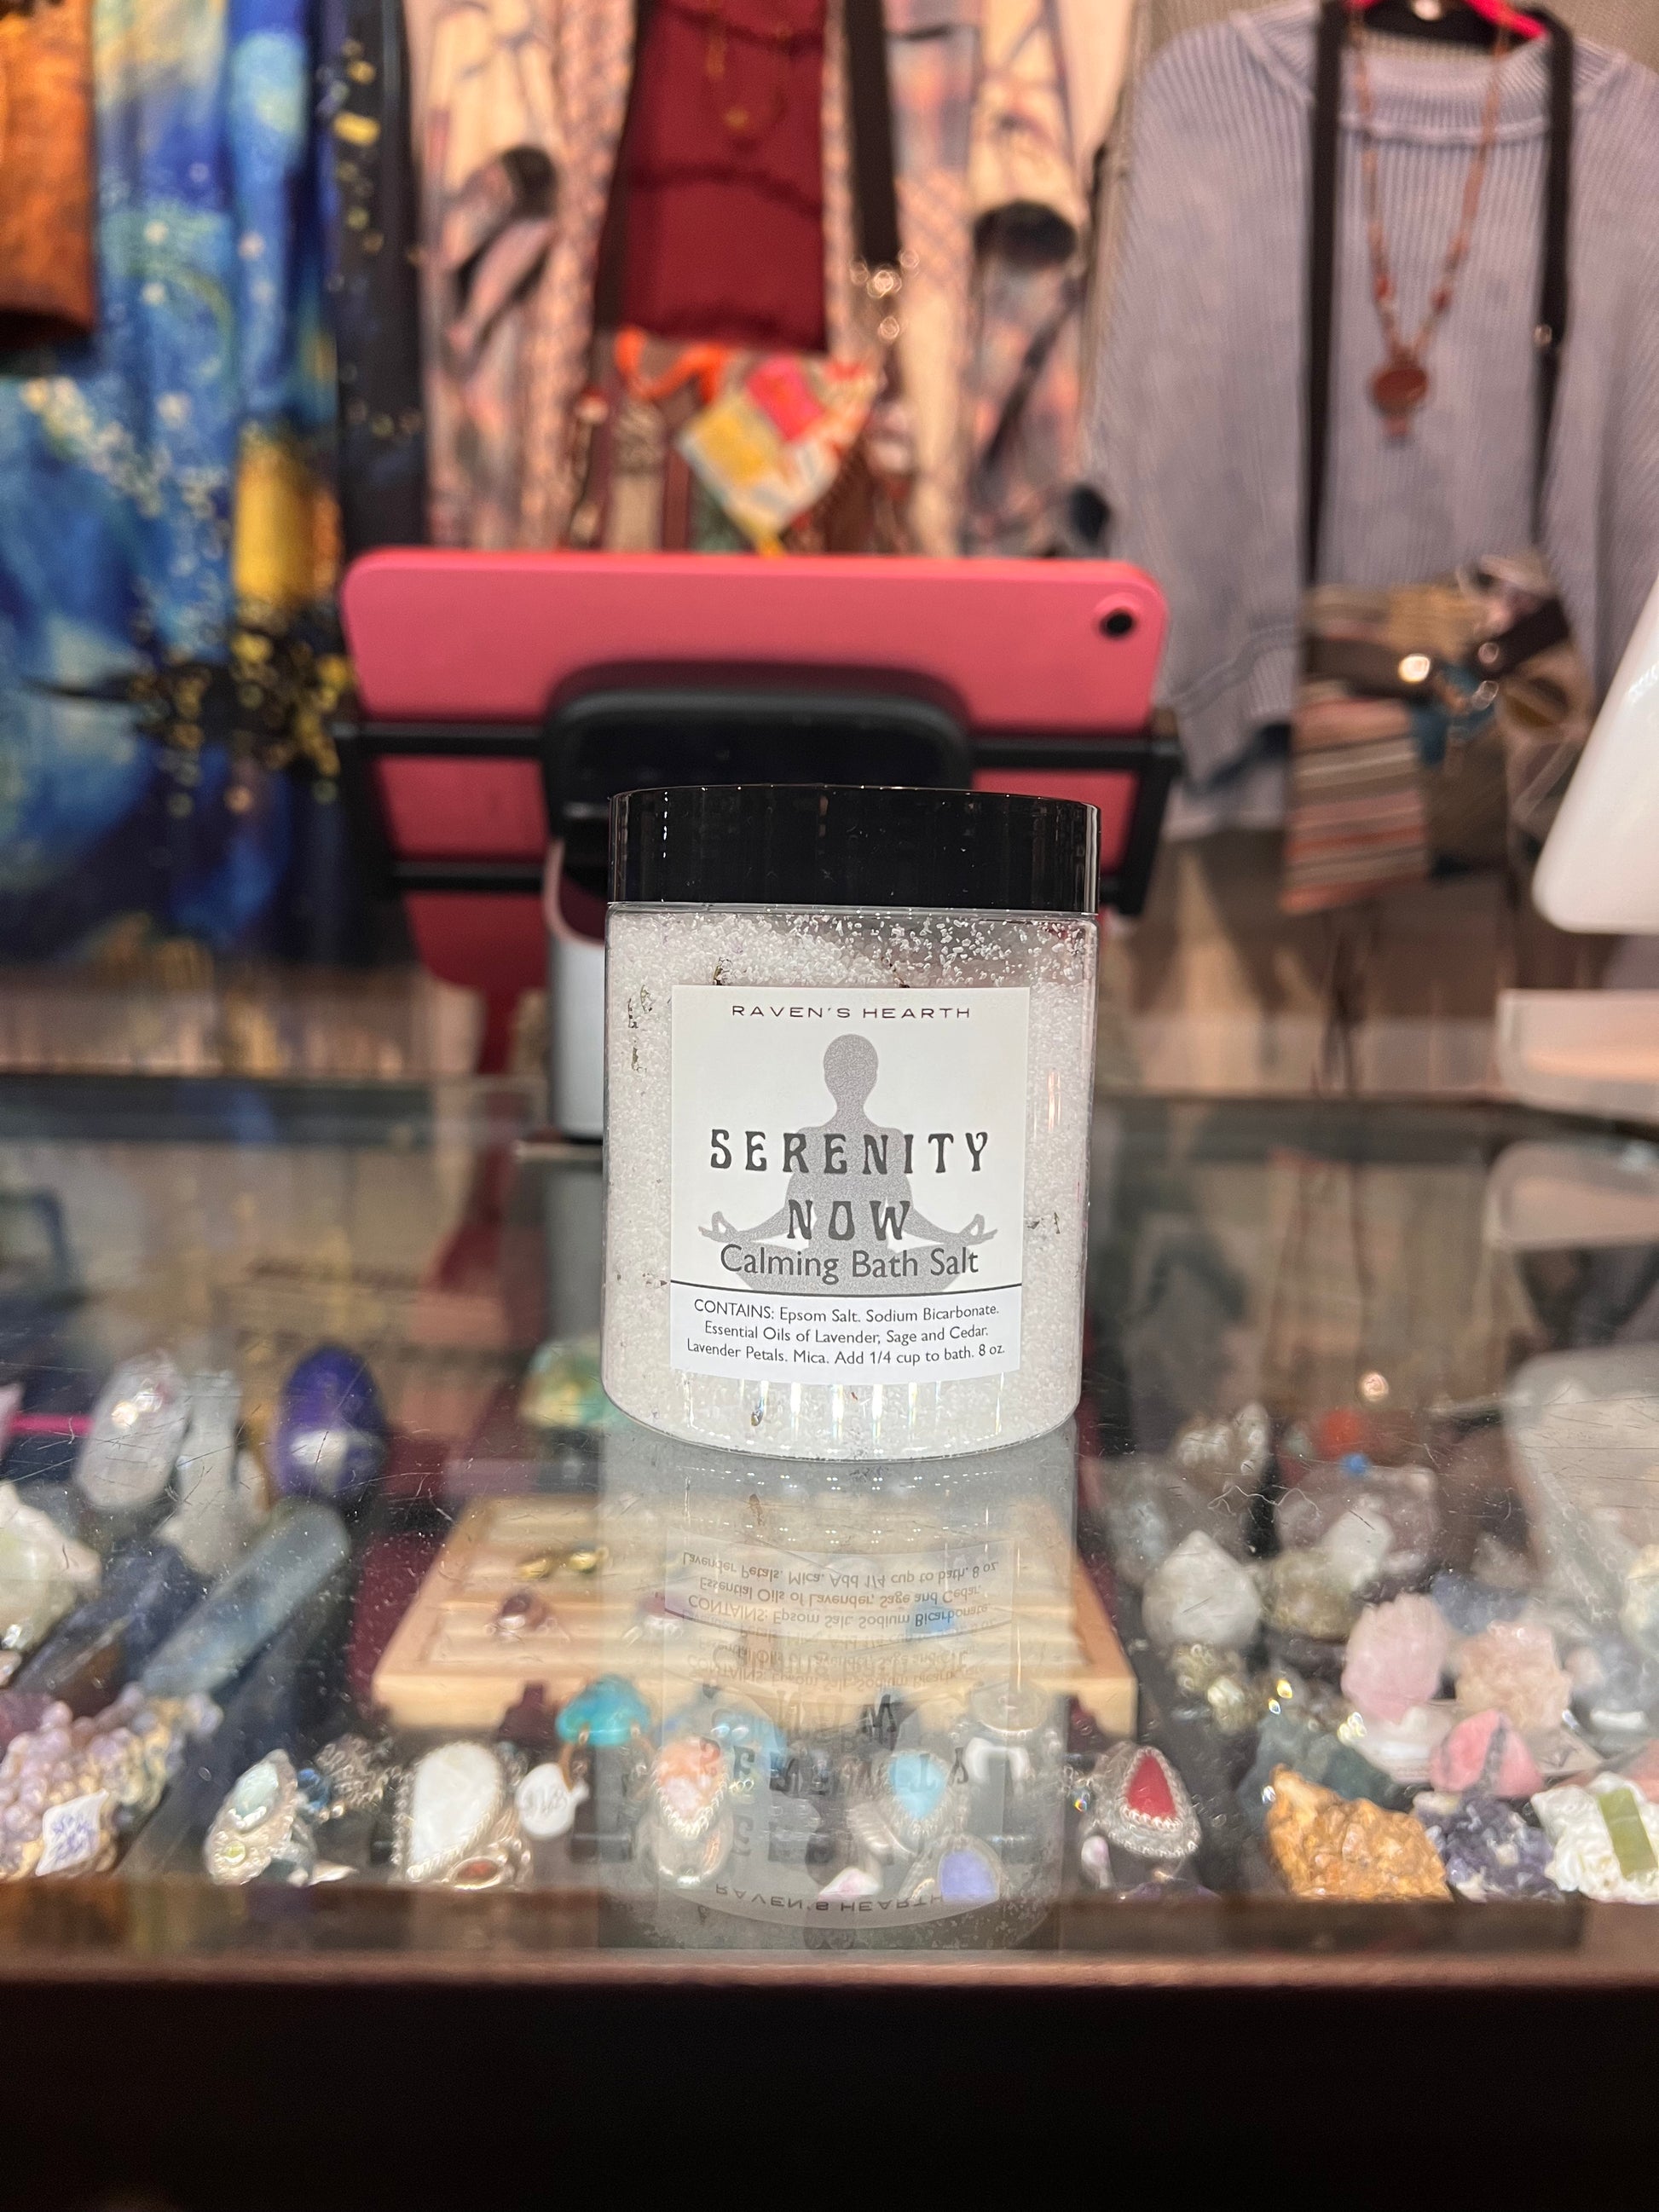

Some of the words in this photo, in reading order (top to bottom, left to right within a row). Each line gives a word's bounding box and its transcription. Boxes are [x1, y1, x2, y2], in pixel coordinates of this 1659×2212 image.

[731, 1005, 851, 1019] RAVEN'S
[863, 1007, 970, 1019] HEARTH
[710, 1128, 988, 1175] SERENITY
[786, 1198, 910, 1241] NOW
[720, 1243, 840, 1285] Calming
[853, 1250, 918, 1279] Bath
[929, 1246, 979, 1276] Salt
[694, 1298, 775, 1320] CONTAINS:
[780, 1306, 827, 1324] Epsom
[831, 1308, 861, 1323] Salt.
[865, 1308, 918, 1323] Sodium
[922, 1305, 999, 1321] Bicarbonate.
[705, 1320, 758, 1339] Essential
[763, 1326, 791, 1342] Oils
[795, 1329, 811, 1343] of
[815, 1329, 882, 1345] Lavender,
[886, 1329, 917, 1346] Sage
[921, 1326, 945, 1342] and
[949, 1324, 989, 1339] Cedar.
[687, 1337, 742, 1358] Lavender
[746, 1345, 788, 1362] Petals.
[793, 1349, 830, 1364] Mica.
[835, 1351, 864, 1365] Add
[870, 1350, 892, 1365] 1/4
[896, 1353, 921, 1366] cup
[925, 1351, 940, 1362] to
[944, 1345, 974, 1361] bath.
[978, 1343, 986, 1357] 8
[989, 1344, 1006, 1355] oz.
